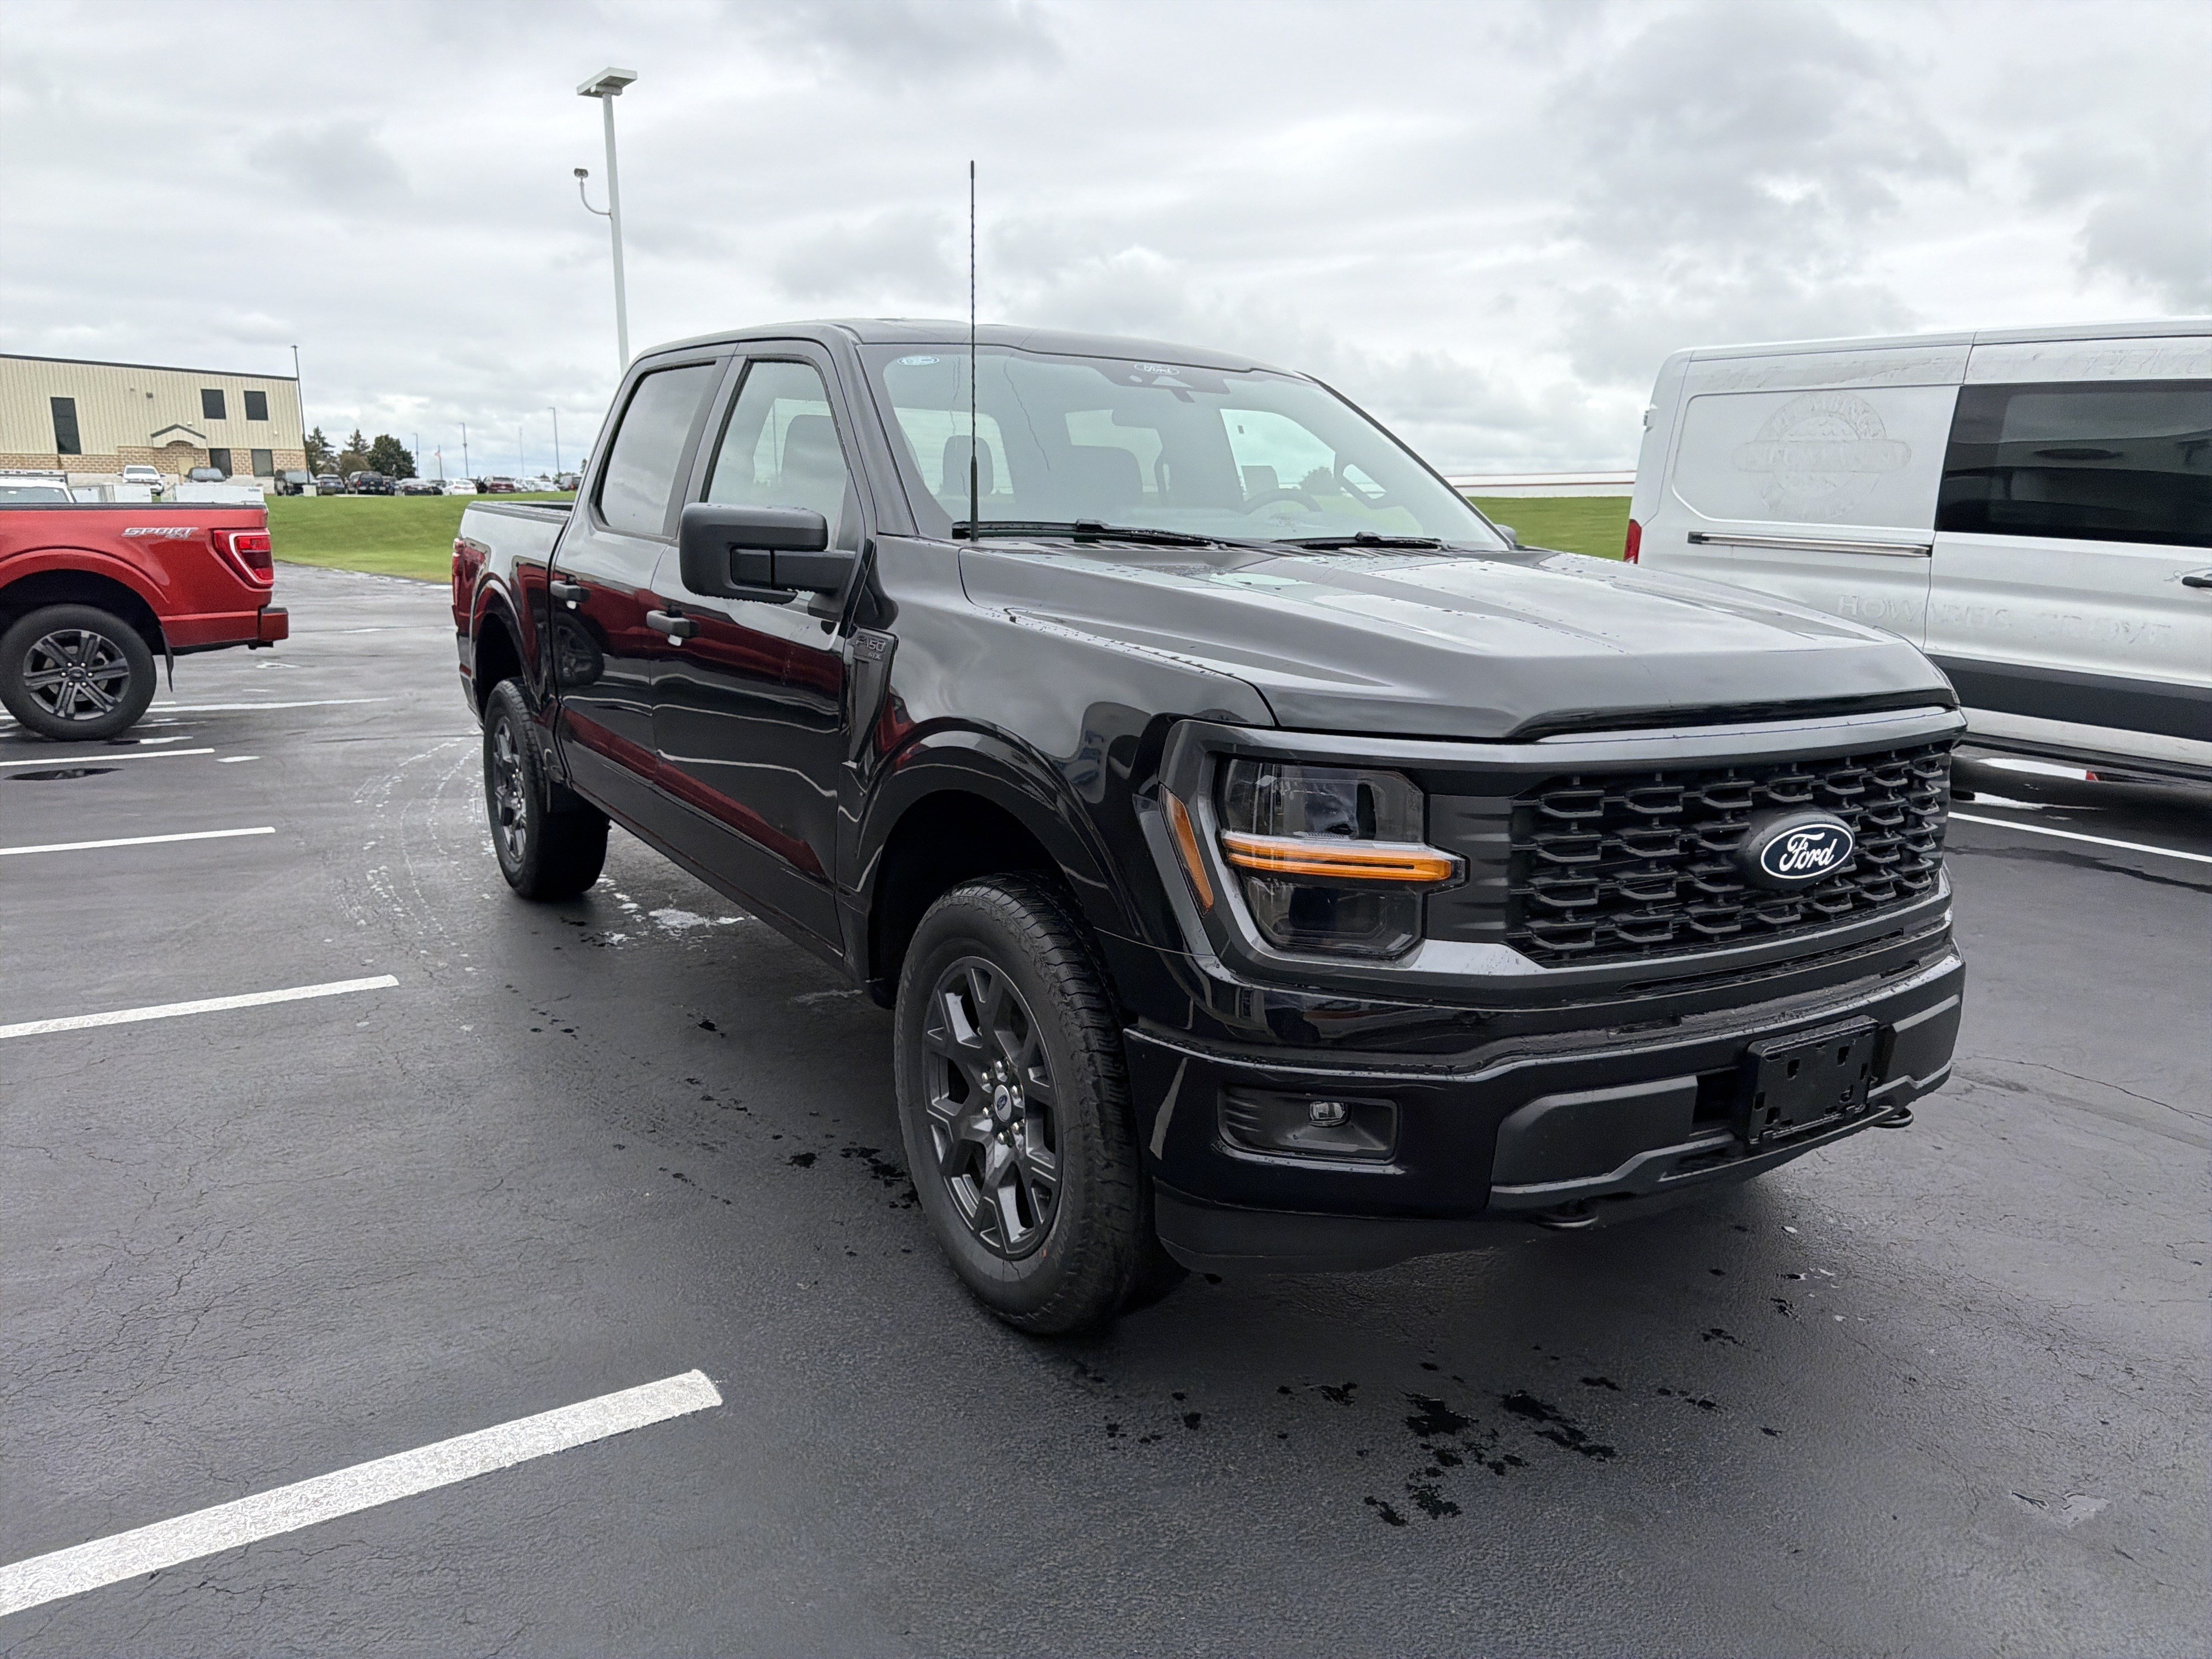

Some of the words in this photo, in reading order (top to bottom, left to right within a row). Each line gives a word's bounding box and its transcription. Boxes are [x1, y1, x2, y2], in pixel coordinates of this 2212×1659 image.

[121, 527, 199, 537] SPORT
[856, 636, 886, 652] F-150
[1779, 832, 1838, 872] Ford
